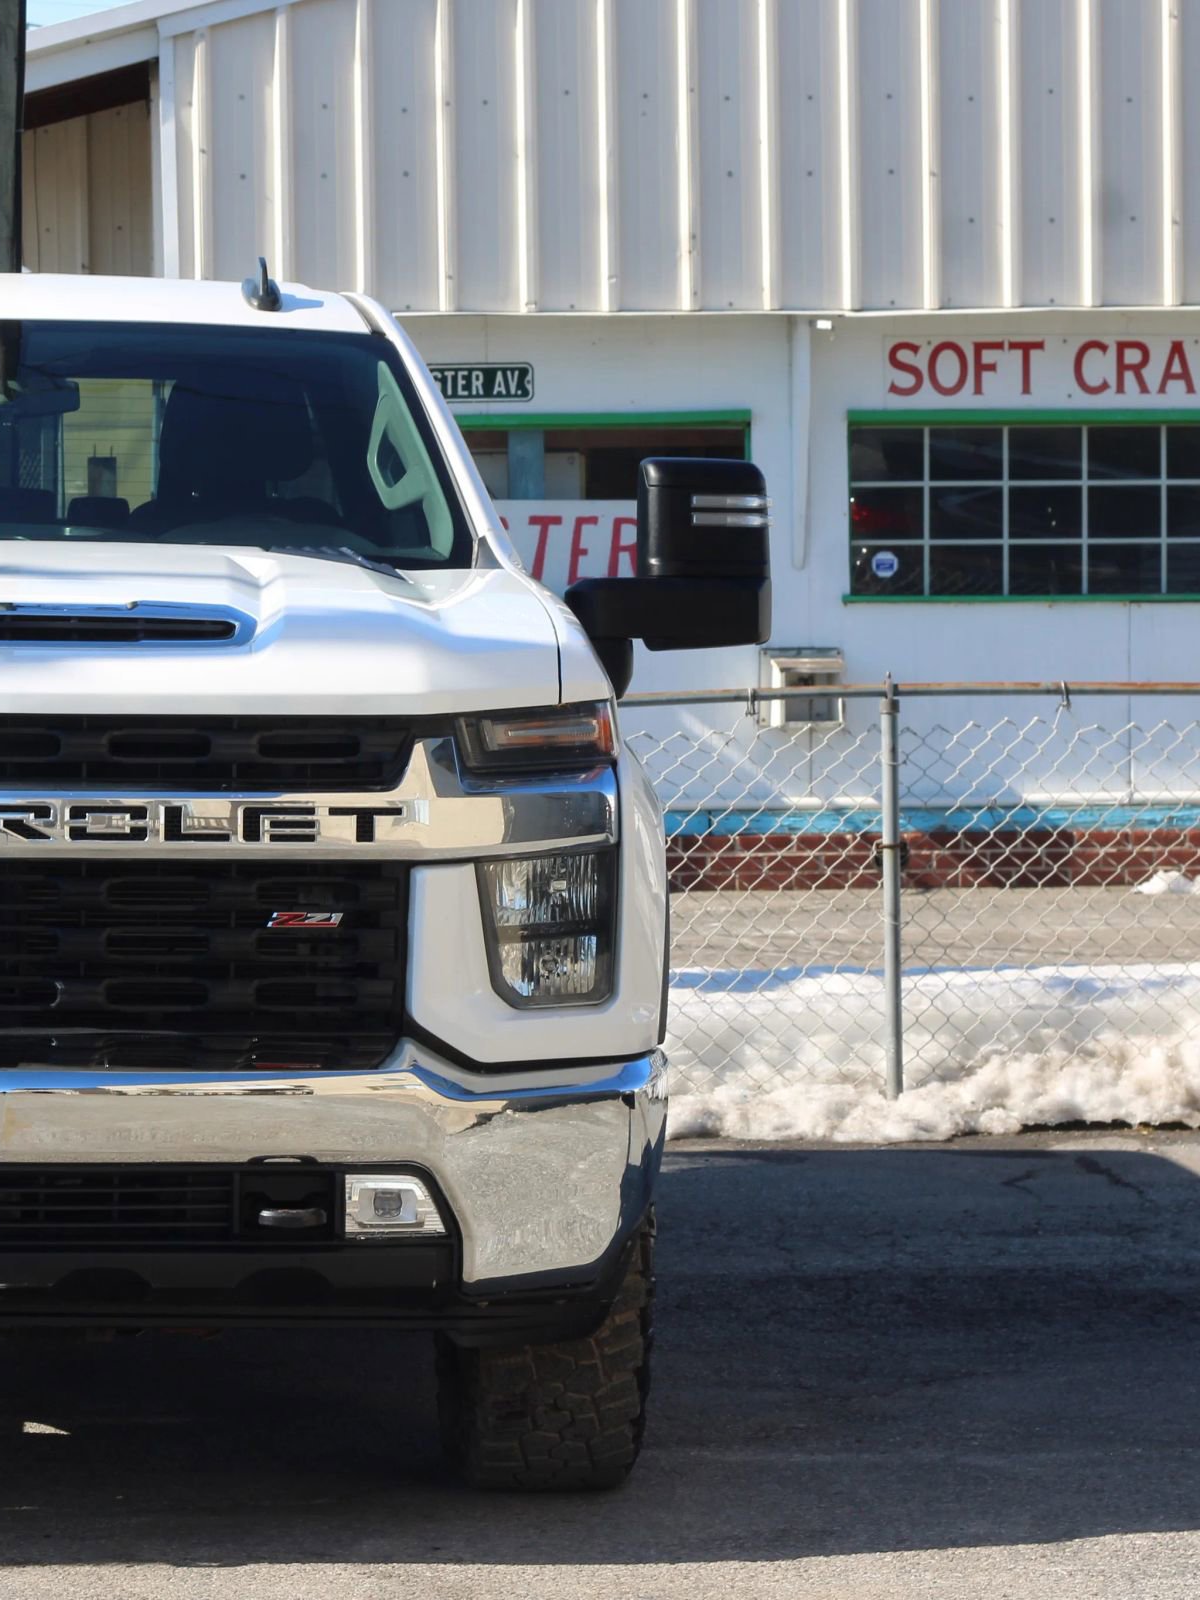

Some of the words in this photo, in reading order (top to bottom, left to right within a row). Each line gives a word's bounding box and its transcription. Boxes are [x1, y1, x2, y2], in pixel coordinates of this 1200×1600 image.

[492, 370, 522, 396] AV.
[887, 339, 1046, 397] SOFT
[1072, 339, 1198, 396] CRA
[499, 514, 638, 586] TER
[267, 911, 344, 928] Z71
